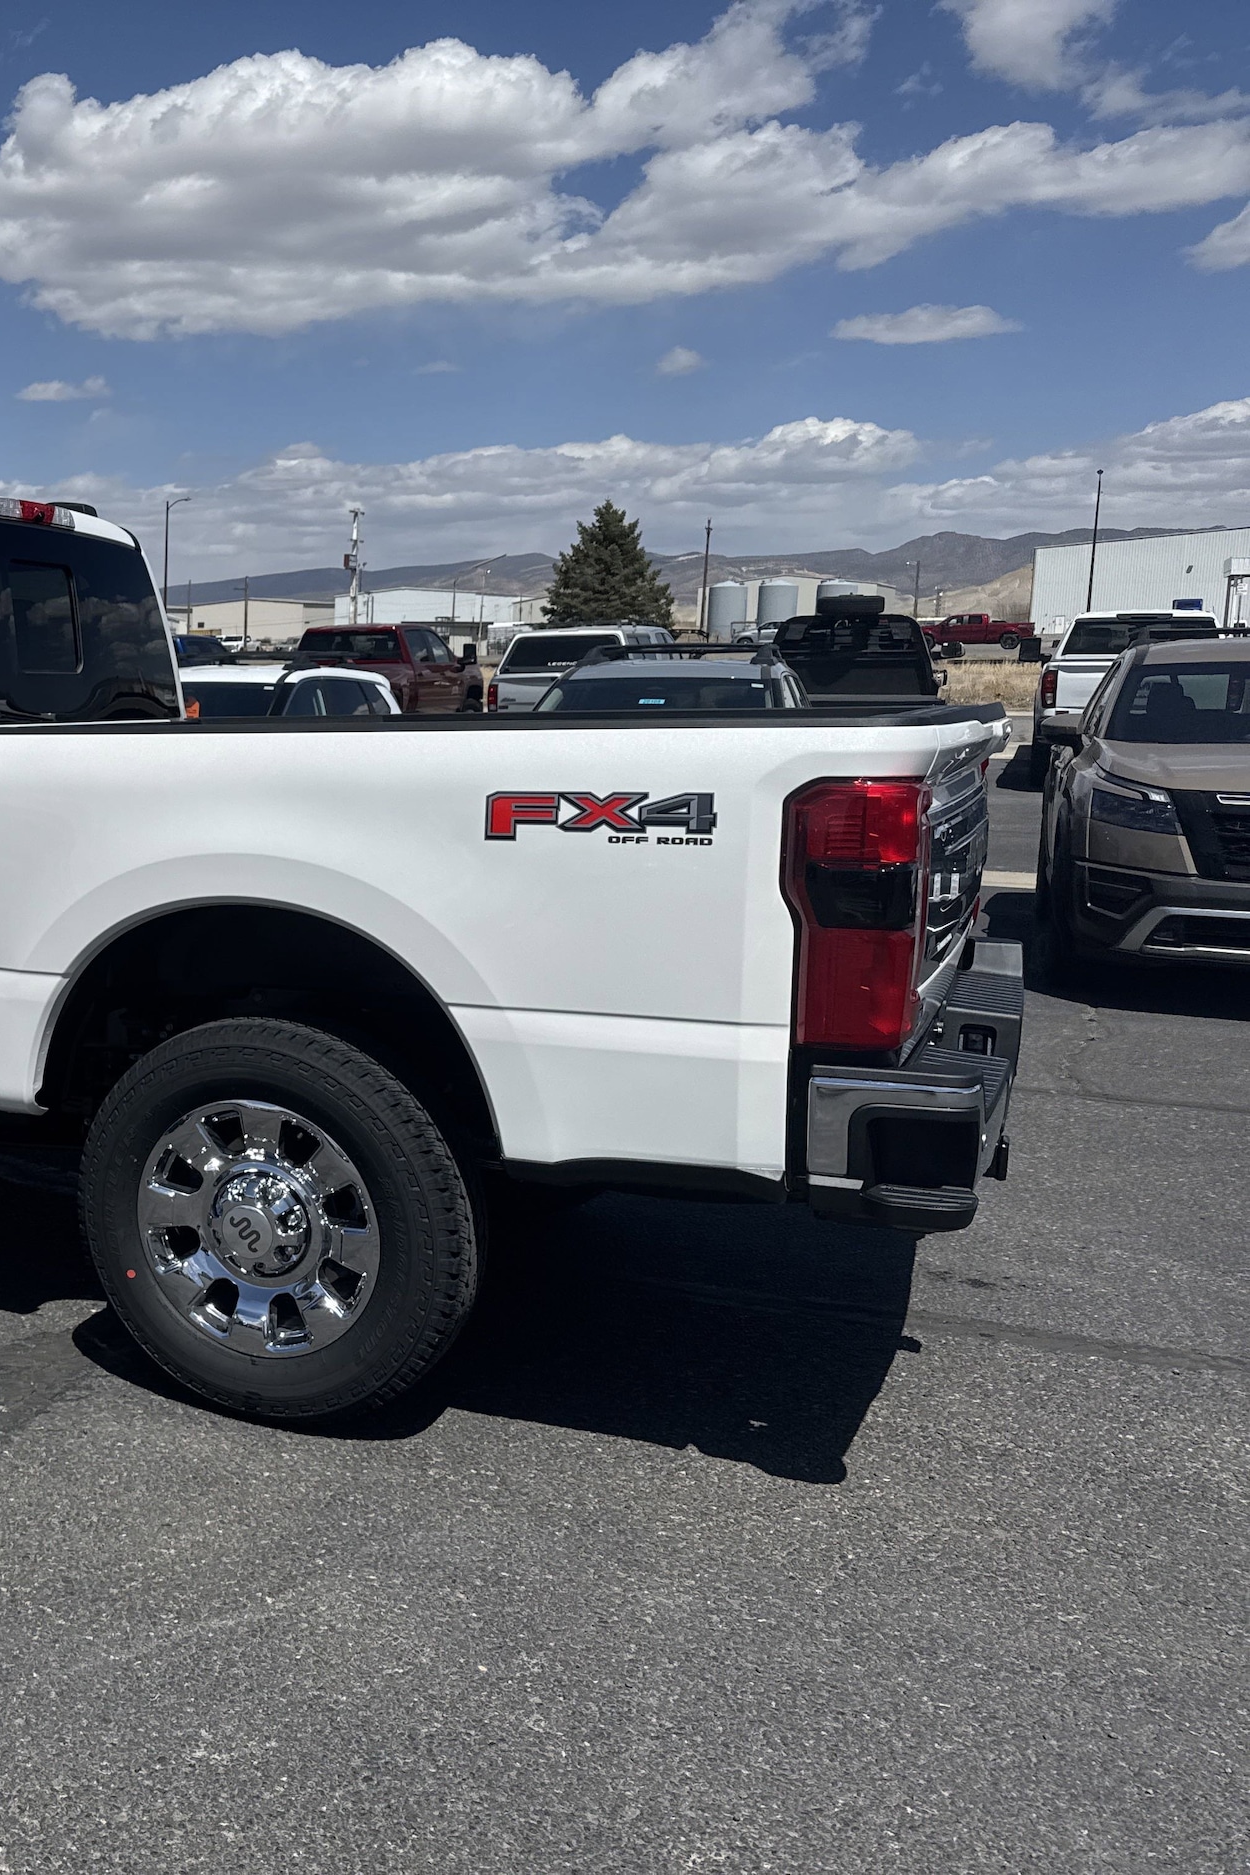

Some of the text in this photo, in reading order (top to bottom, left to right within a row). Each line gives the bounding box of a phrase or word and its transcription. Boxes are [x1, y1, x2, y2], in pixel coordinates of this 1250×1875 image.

[484, 791, 717, 841] FX4
[607, 836, 713, 846] OFF ROAD
